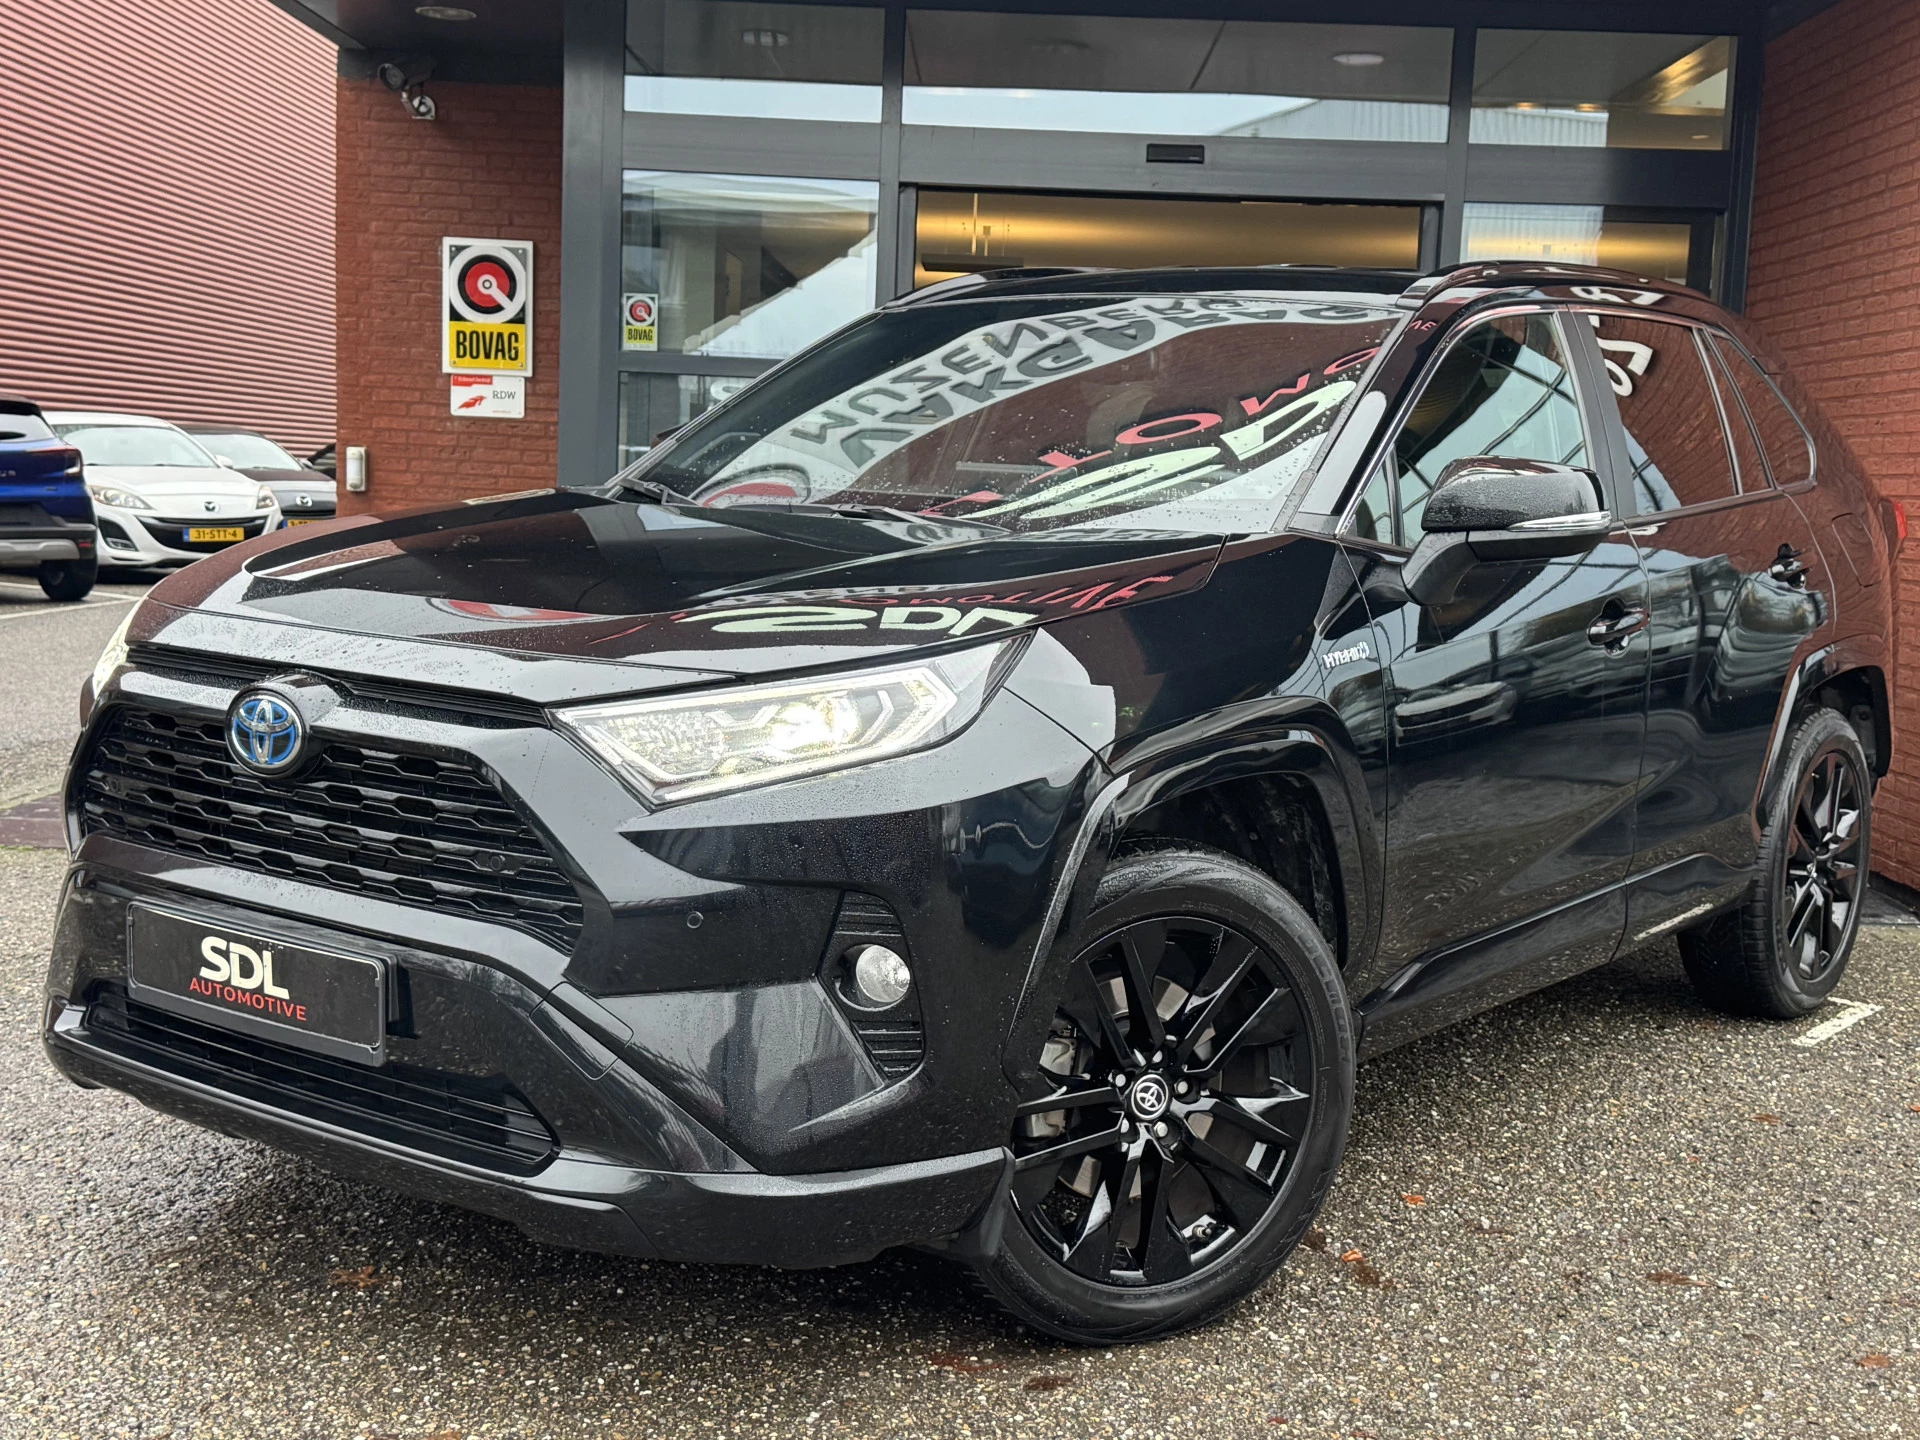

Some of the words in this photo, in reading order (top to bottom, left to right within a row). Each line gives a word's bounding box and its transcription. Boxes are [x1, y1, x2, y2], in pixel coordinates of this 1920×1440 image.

[455, 329, 520, 361] BOVAG
[627, 328, 653, 341] BOVAG
[492, 390, 516, 400] RDW
[200, 936, 290, 1000] SDL
[189, 977, 307, 1022] AUTOMOTIVE
